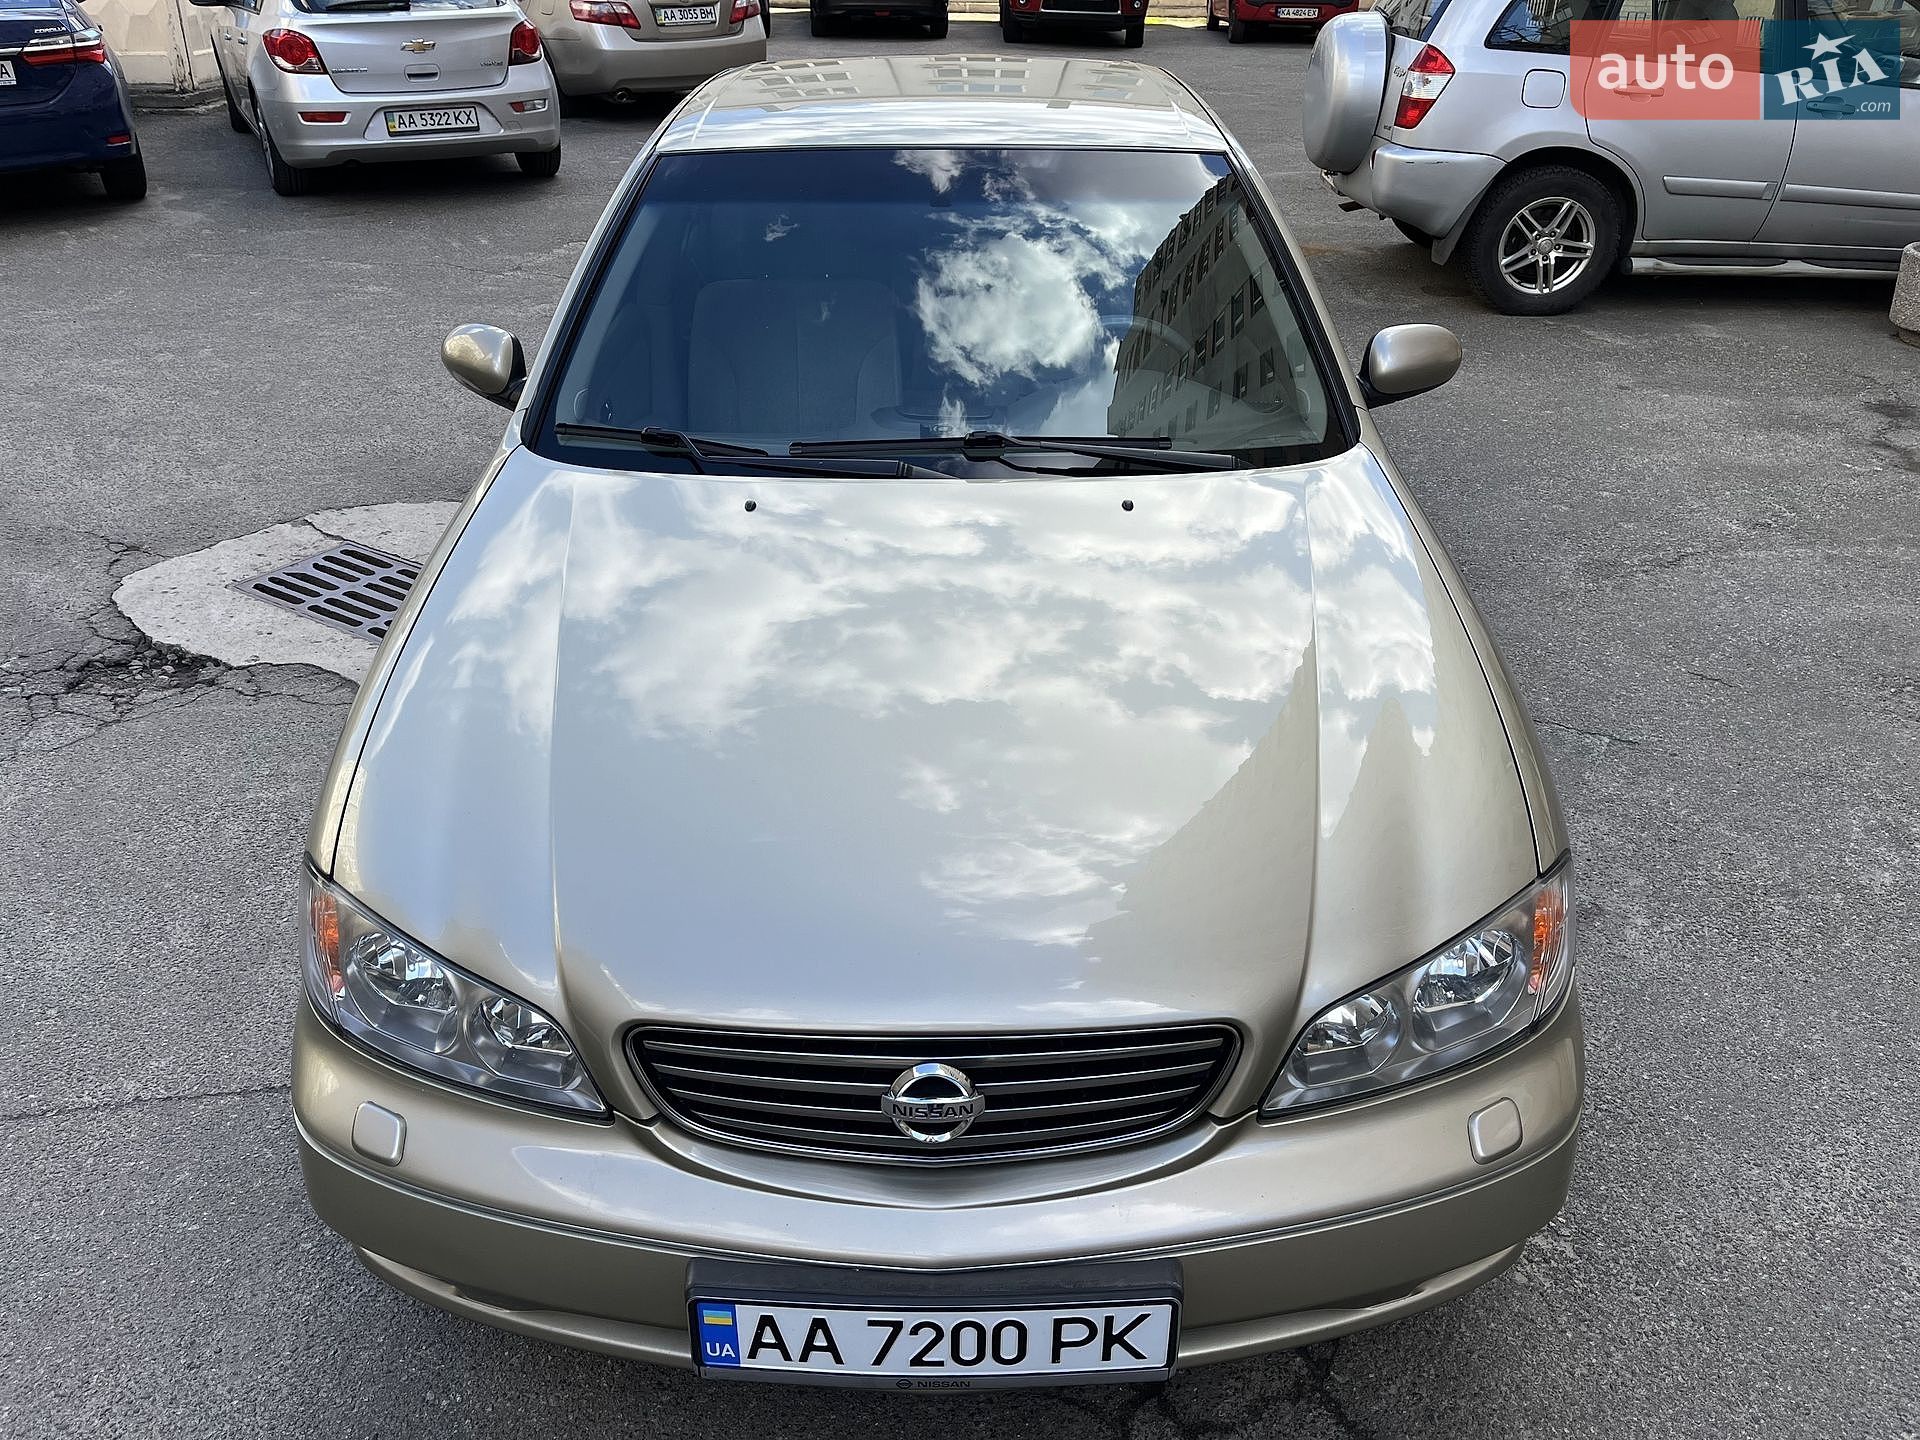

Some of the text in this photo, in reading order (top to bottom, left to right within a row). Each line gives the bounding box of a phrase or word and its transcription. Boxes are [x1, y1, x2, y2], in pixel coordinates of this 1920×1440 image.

[663, 8, 714, 21] AA 3055 BM
[398, 110, 475, 128] AA 5322 KX
[892, 1103, 974, 1118] NISSAN
[746, 1312, 1152, 1367] AA 7200 PK
[705, 1342, 736, 1359] UA
[917, 1380, 971, 1388] NISSAN
